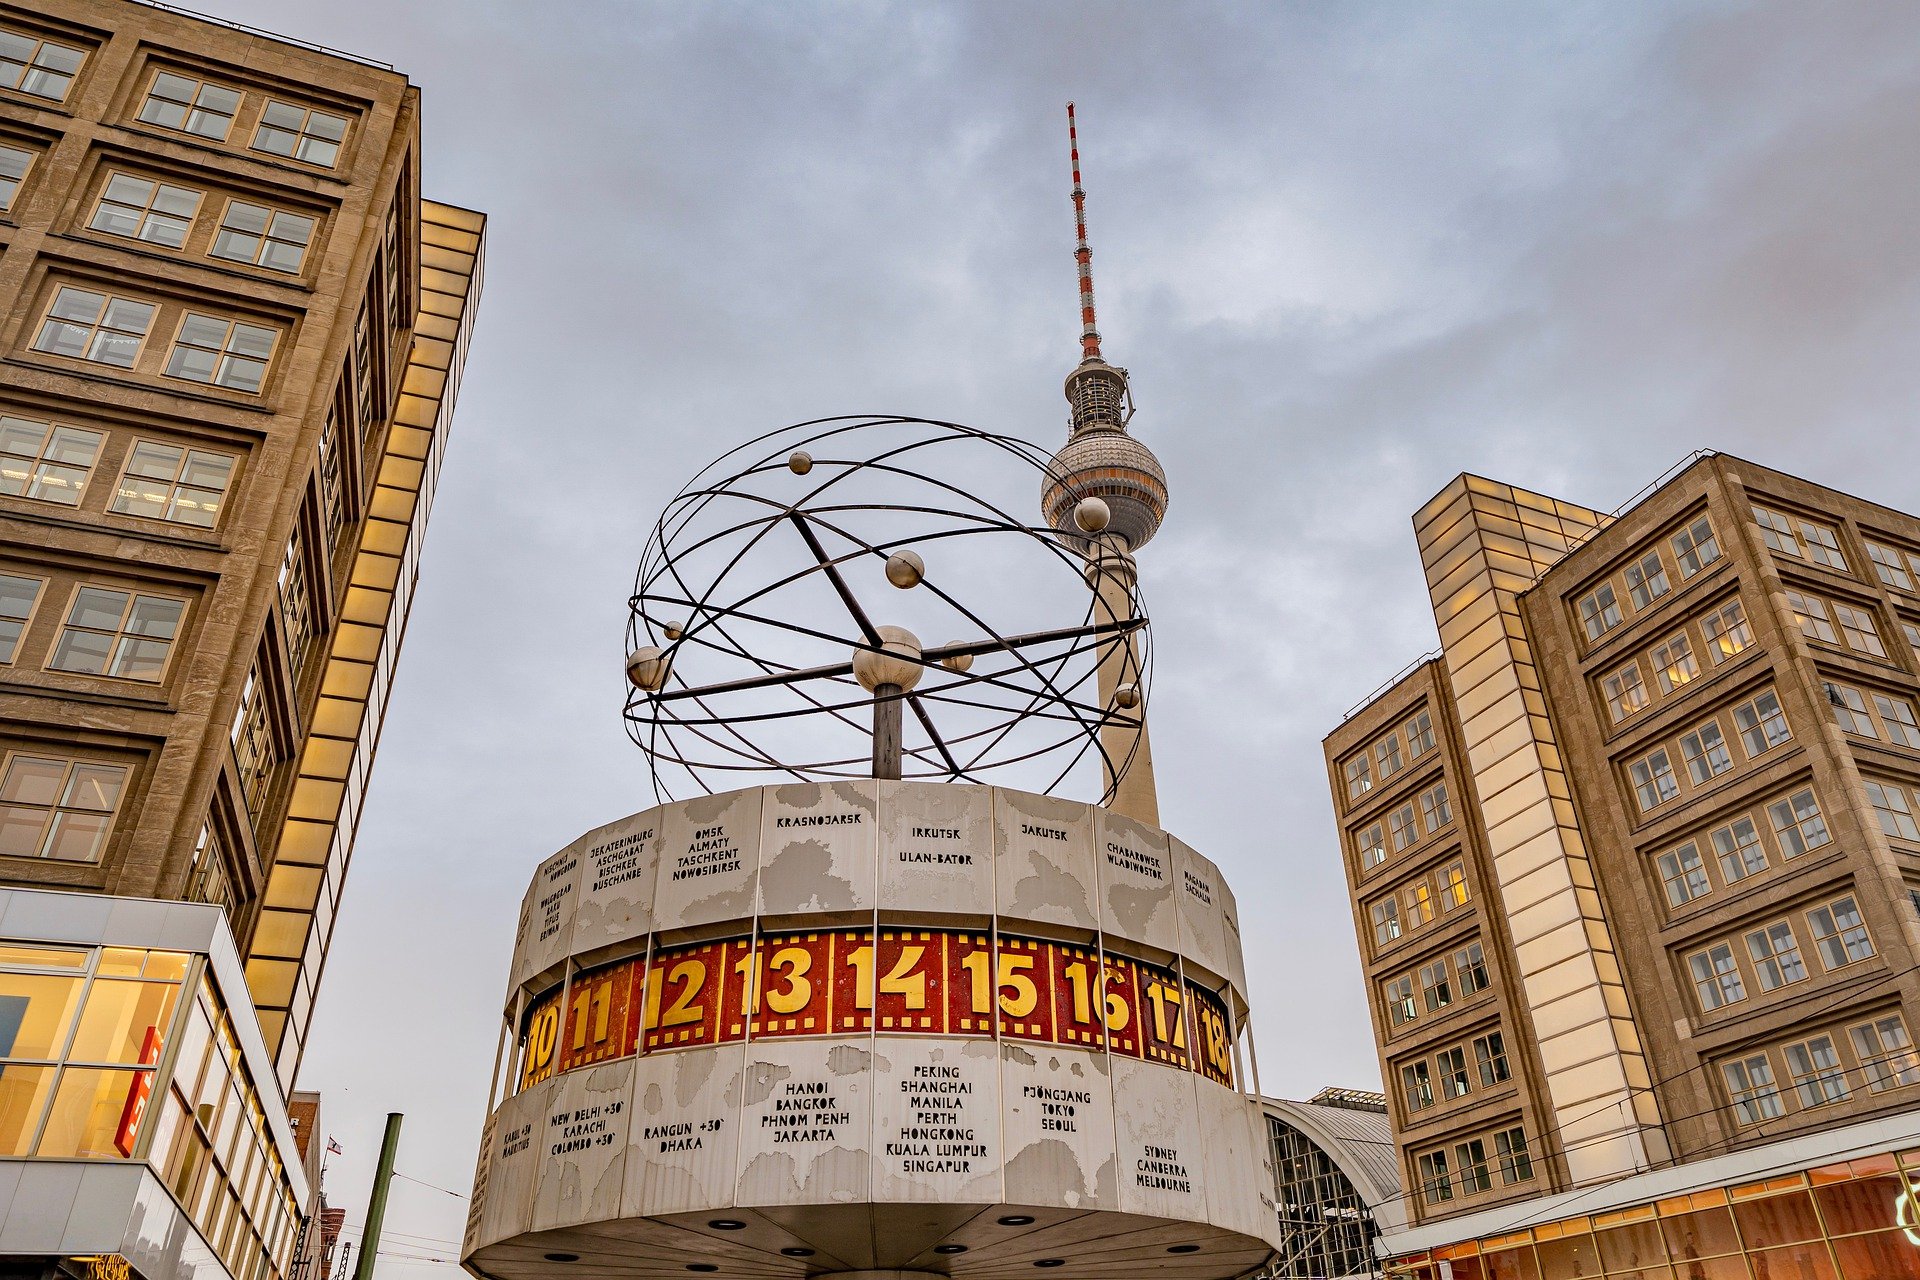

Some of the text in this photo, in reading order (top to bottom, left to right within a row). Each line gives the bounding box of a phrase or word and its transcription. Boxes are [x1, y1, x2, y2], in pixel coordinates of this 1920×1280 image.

[777, 814, 861, 828] KRASNOJARSK
[695, 826, 724, 840] OMSK
[912, 827, 961, 839] IRKUTSK
[1021, 824, 1068, 841] JAKUTSK
[590, 829, 653, 858] JEKATERINBURG
[688, 837, 730, 853] ALMATY
[596, 844, 644, 868] ASCHGABAT
[678, 848, 738, 867] TASCHKENT
[899, 852, 973, 865] ULAN-BATOR
[1107, 842, 1161, 868] CHABAROWSK
[599, 857, 637, 878] BISCHKEK
[673, 860, 741, 881] NOWOSIBIRSK
[1107, 853, 1163, 881] WLADIWOSTOK
[593, 868, 641, 892] DUSCHANBE
[527, 945, 1228, 1075] 10 11 12 13 14 15 16 17 18
[914, 1066, 960, 1078] PEKING
[786, 1082, 828, 1095] HANOI
[901, 1081, 972, 1094] SHANGHAI
[1023, 1085, 1091, 1104] PJÖNGJANG
[776, 1097, 836, 1111] BANGKOK
[911, 1096, 963, 1109] MANILA
[1041, 1103, 1075, 1117] TOKYO
[551, 1113, 570, 1127] NEW
[575, 1106, 600, 1121] DELHI
[761, 1112, 849, 1127] PHNOM PENH
[917, 1112, 956, 1124] PERTH
[563, 1120, 606, 1138] KARACHI
[644, 1123, 692, 1139] RANGUN
[1041, 1118, 1077, 1132] SEOUL
[774, 1129, 835, 1142] JAKARTA
[901, 1128, 974, 1141] HONGKONG
[551, 1138, 592, 1155] COLOMBO
[660, 1137, 702, 1153] DHAKA
[886, 1143, 987, 1157] KUALA LUMPUR
[1144, 1145, 1177, 1161] SYDNEY
[903, 1160, 970, 1173] SINGAPUR
[1137, 1159, 1188, 1177] CANBERRA
[1136, 1174, 1191, 1193] MELBOURNE
